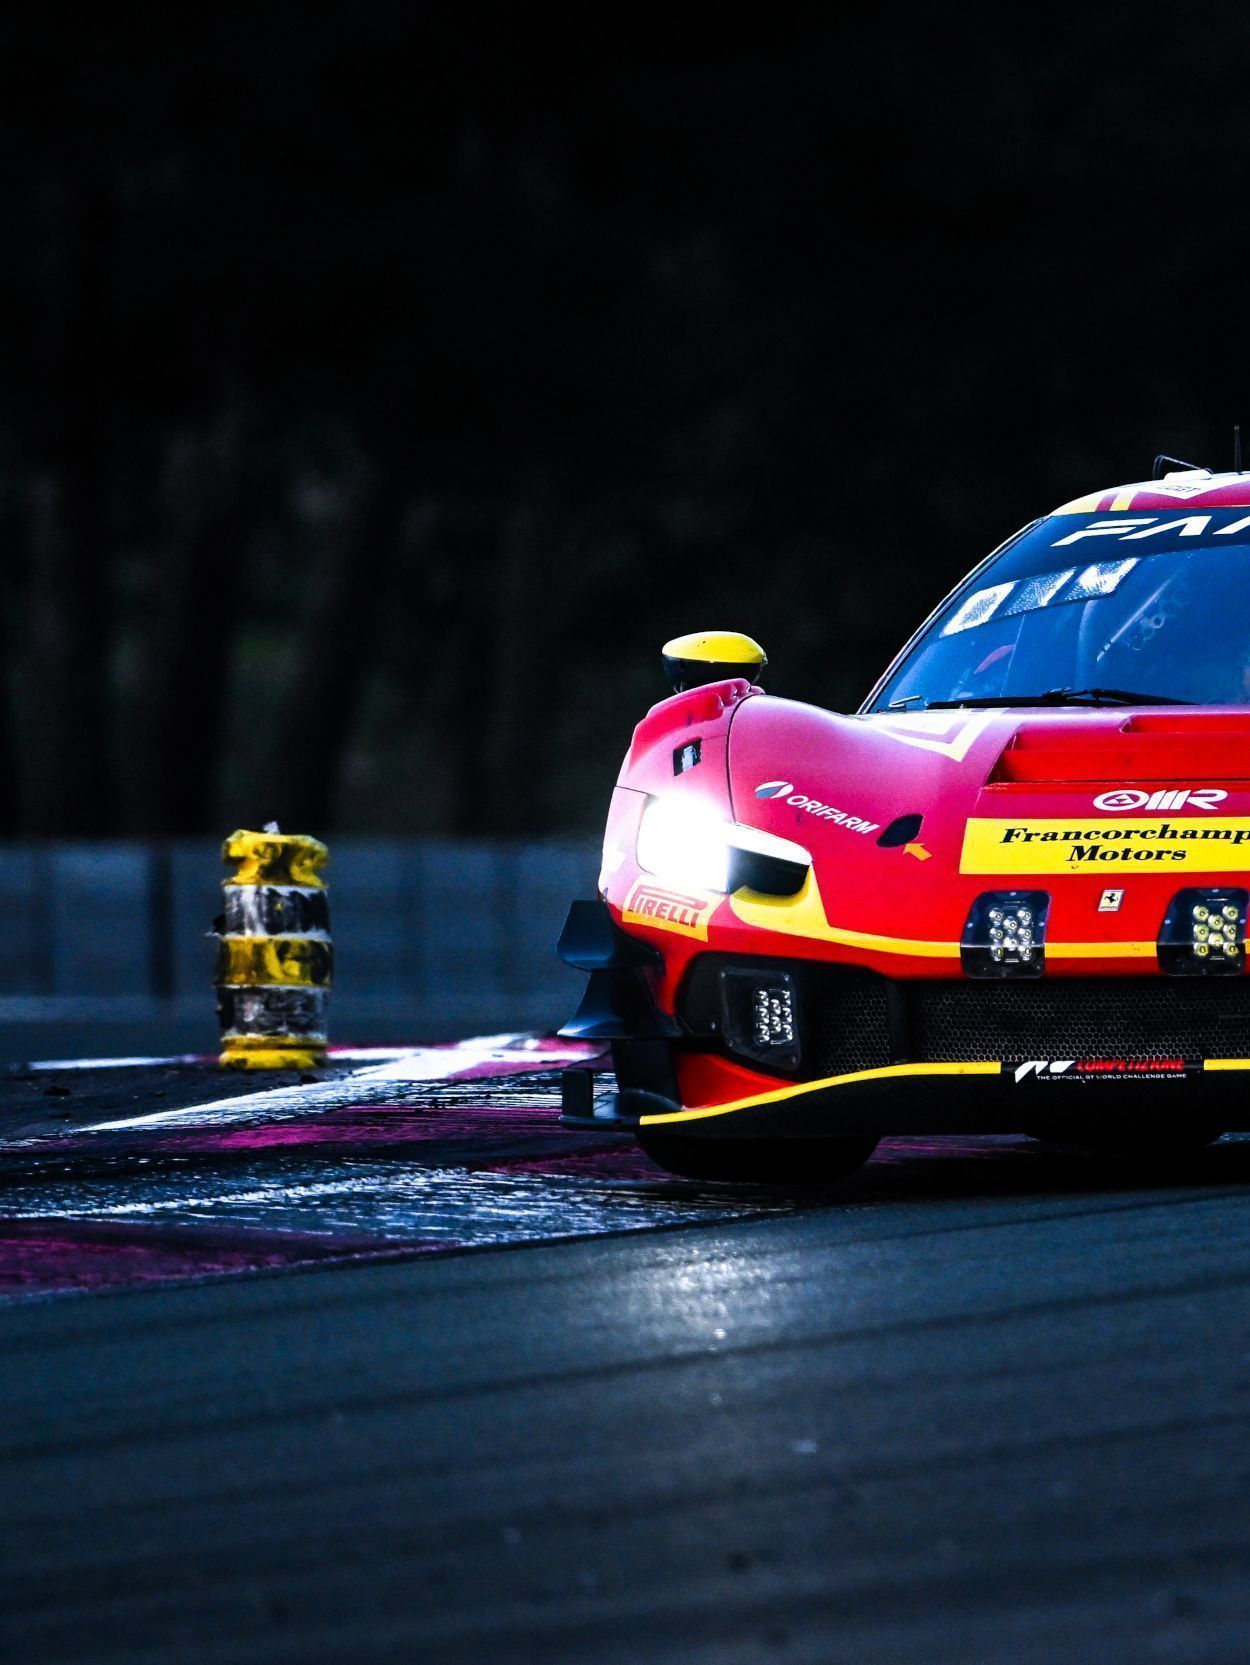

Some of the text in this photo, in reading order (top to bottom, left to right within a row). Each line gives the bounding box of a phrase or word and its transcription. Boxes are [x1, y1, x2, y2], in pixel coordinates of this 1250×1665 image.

[786, 795, 880, 835] ORIFARM
[1065, 844, 1187, 862] Motors
[627, 884, 709, 929] PIRELLI
